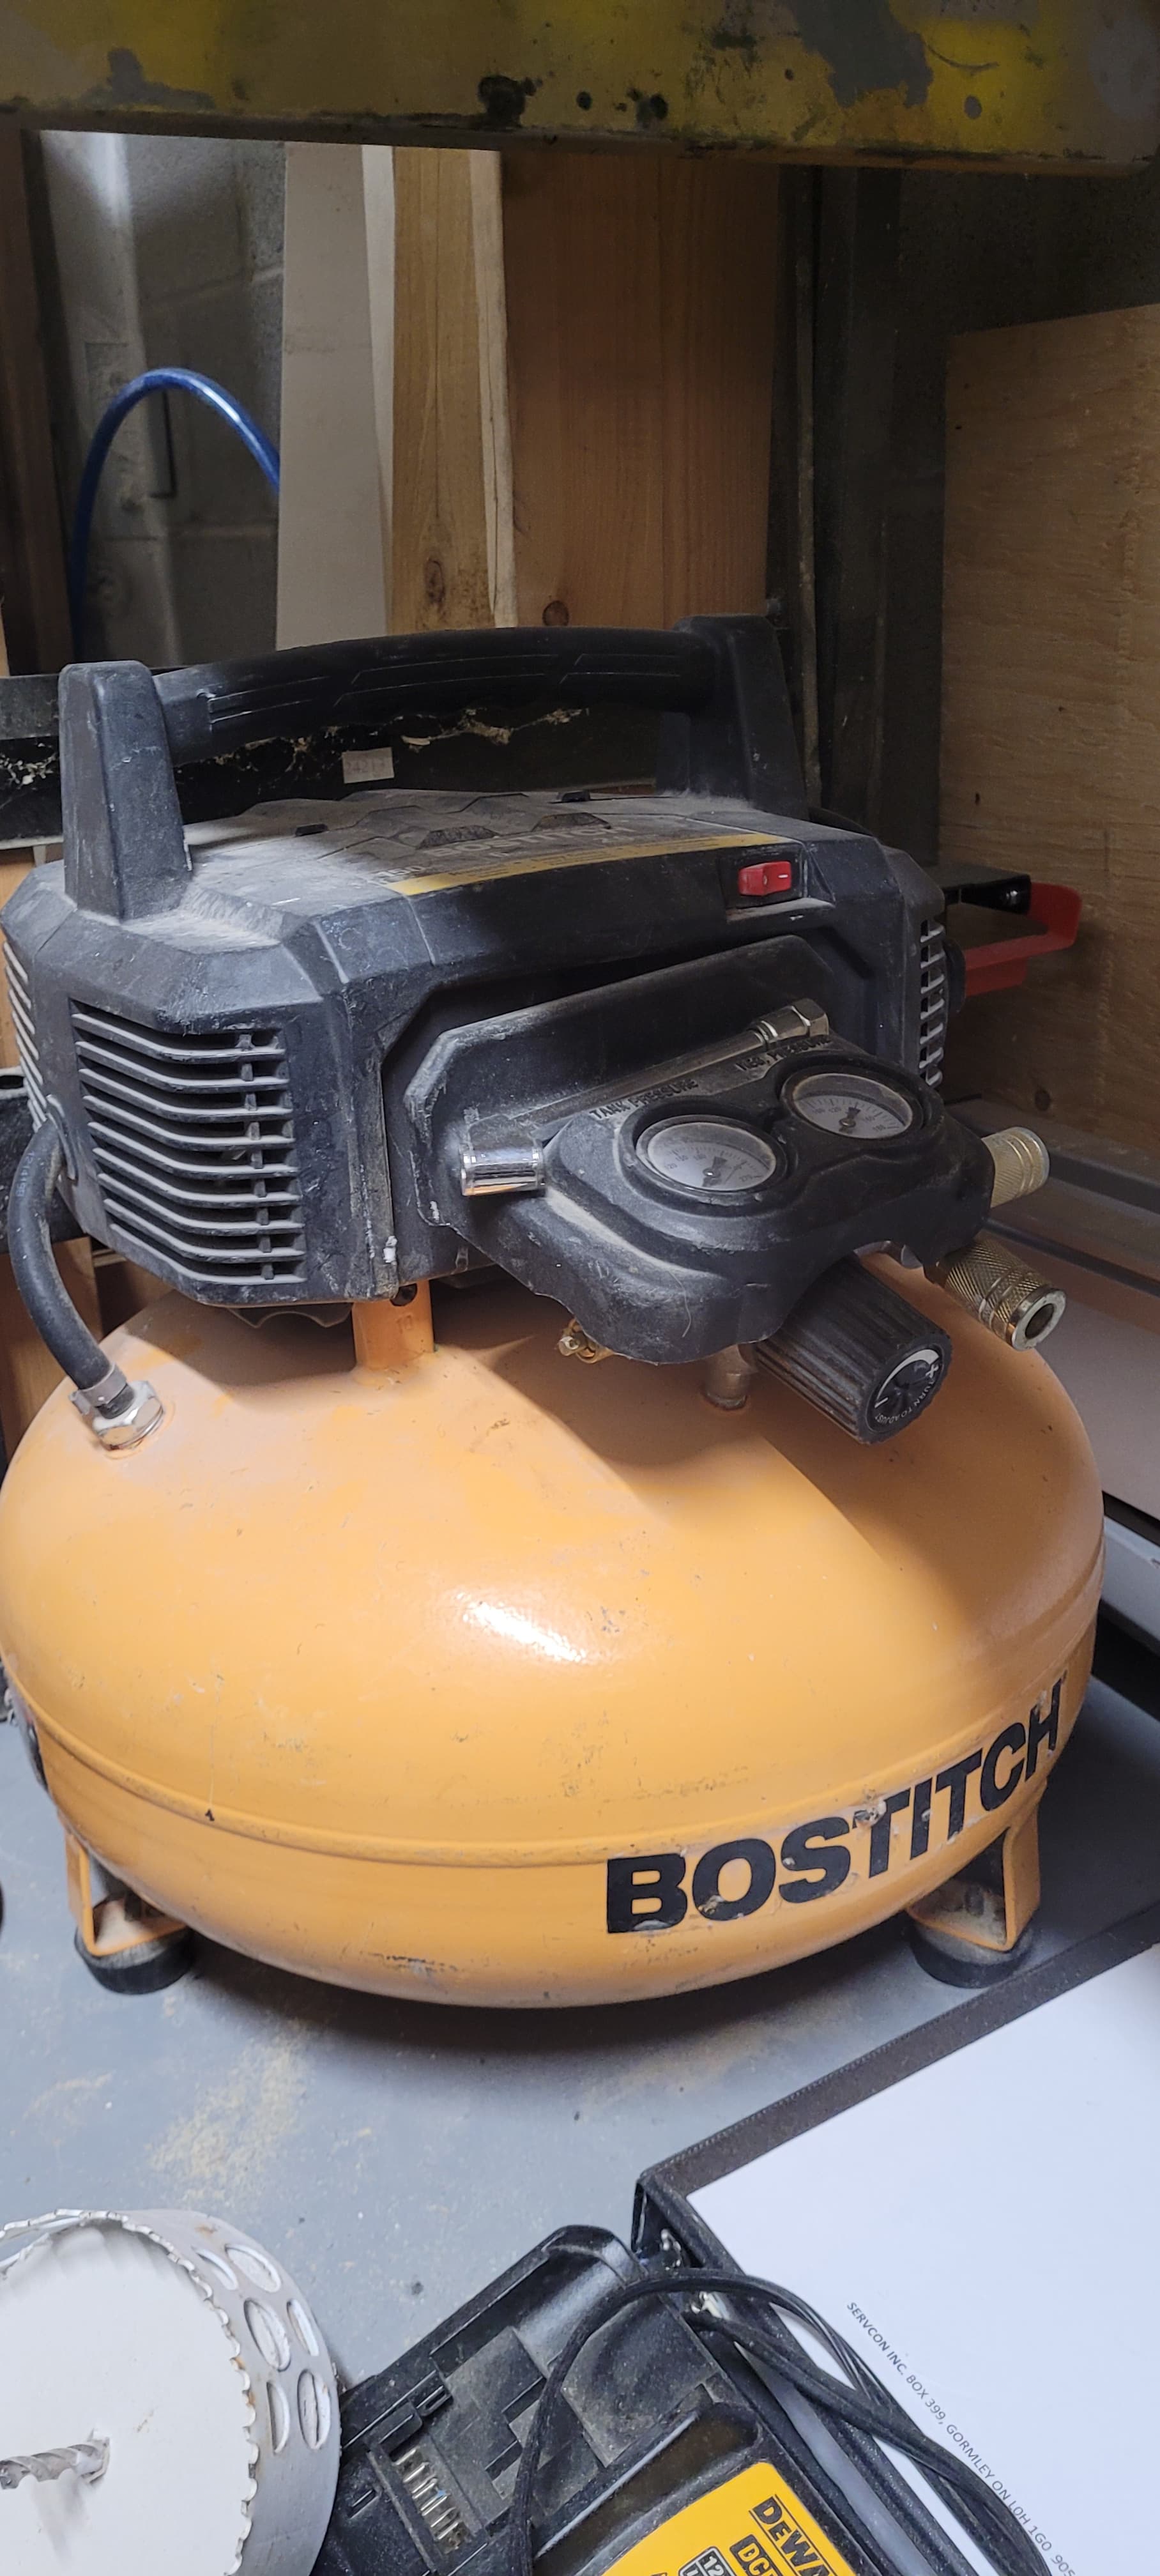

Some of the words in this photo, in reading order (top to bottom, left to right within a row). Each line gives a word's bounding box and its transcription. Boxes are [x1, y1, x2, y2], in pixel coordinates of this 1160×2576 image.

[422, 826, 635, 857] BOSTITCH
[628, 1078, 699, 1108] PRESSURE
[589, 1100, 630, 1119] TANK
[913, 1377, 936, 1406] TURN
[901, 1406, 913, 1418] TO
[607, 1671, 1065, 1933] BOSTITCH
[847, 2301, 890, 2351] SERVCON
[887, 2351, 907, 2375] INC.
[906, 2374, 929, 2400] BOX
[925, 2398, 946, 2425] 399,
[946, 2424, 995, 2479] GORMLEY
[991, 2480, 1012, 2501] ON
[738, 2542, 779, 2576] DC
